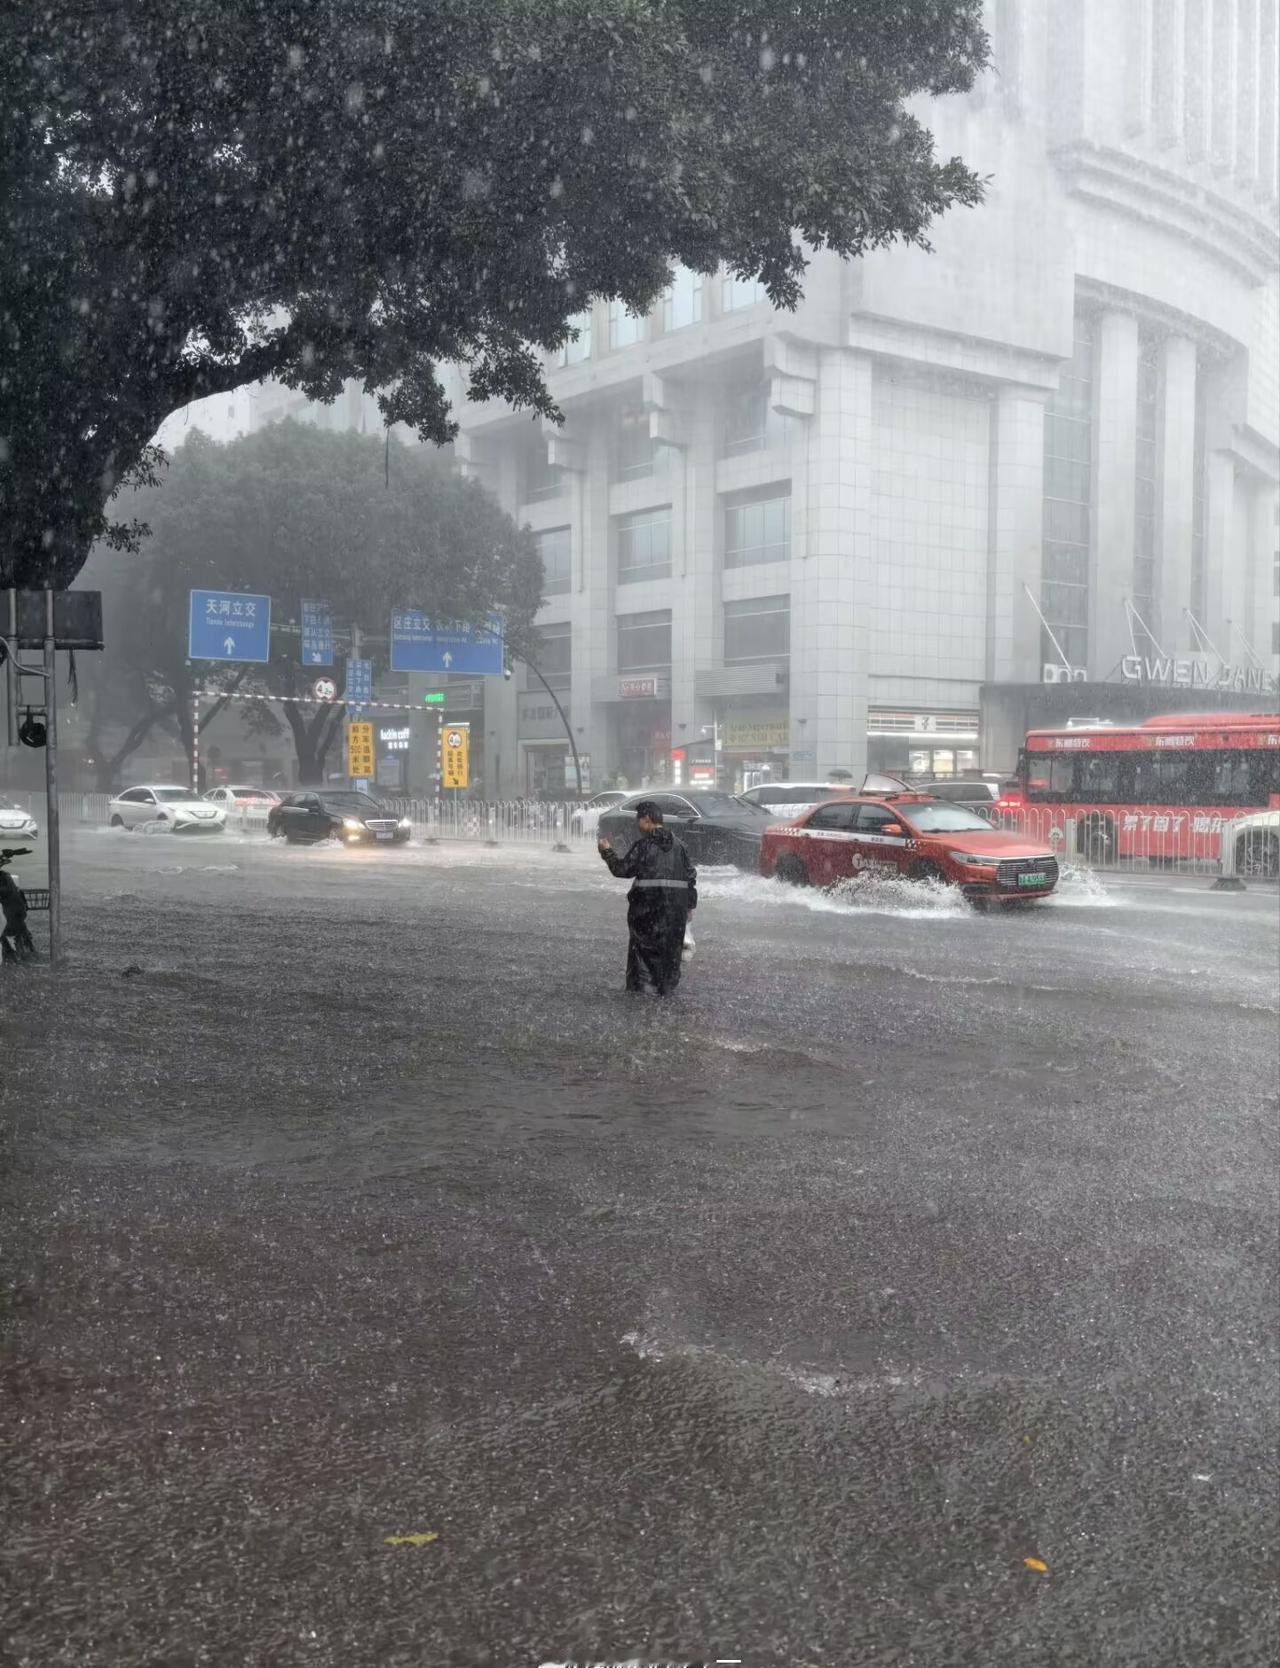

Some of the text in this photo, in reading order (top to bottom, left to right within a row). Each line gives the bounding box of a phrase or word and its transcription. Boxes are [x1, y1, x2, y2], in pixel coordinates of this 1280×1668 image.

[205, 598, 257, 617] 天河立交
[1121, 655, 1209, 684] GWEN
